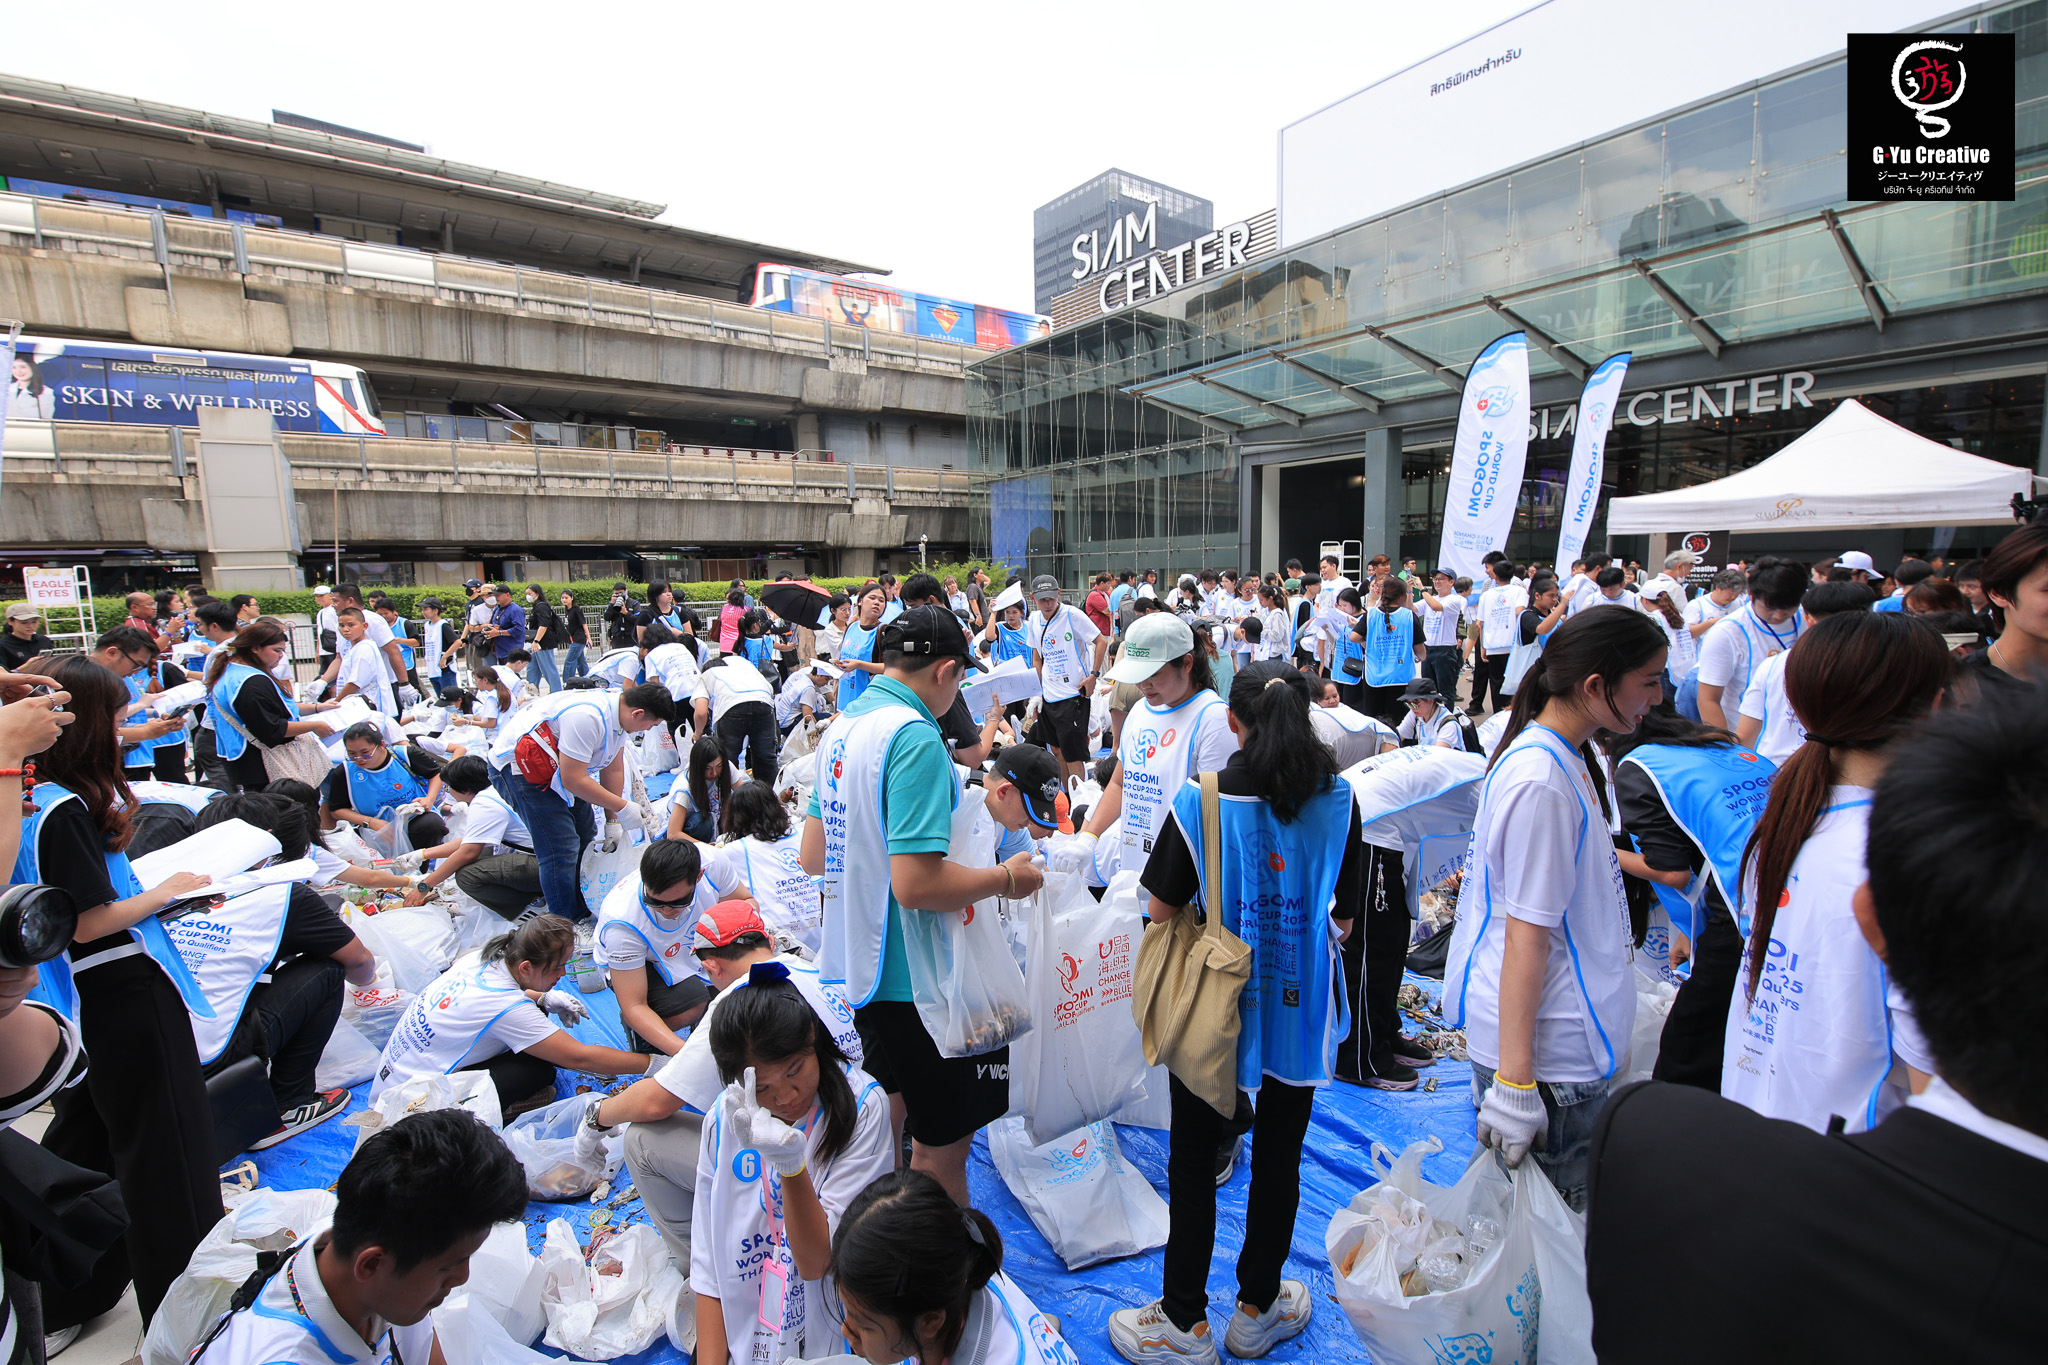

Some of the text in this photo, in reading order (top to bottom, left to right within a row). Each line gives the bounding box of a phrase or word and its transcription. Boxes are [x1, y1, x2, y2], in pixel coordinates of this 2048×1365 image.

[1430, 48, 1522, 97] สิทธิพิเศษสำหรับ
[1071, 200, 1158, 280] SIAM
[1099, 221, 1251, 314] CENTER
[62, 385, 135, 408] SKIN
[143, 393, 163, 410] &
[1626, 371, 1816, 427] CENTER
[1754, 511, 1775, 519] SIAM
[32, 580, 72, 589] EAGLE
[38, 589, 70, 598] EYES
[357, 772, 365, 781] 3
[1132, 784, 1163, 797] CUP 2025
[1139, 793, 1162, 805] Qualifiers
[1726, 792, 1767, 811] WORLD
[1129, 803, 1152, 815] CHANGE
[1734, 804, 1764, 820] THAIL
[775, 874, 811, 889] SPOGO
[775, 884, 799, 896] WORLD
[1258, 911, 1281, 921] CUP
[165, 919, 233, 936] OGOMI
[178, 929, 232, 945] CUP 2025
[1114, 933, 1130, 946] 日本
[187, 939, 227, 954] Qualifiers
[670, 944, 678, 956] 2
[1258, 937, 1297, 953] CHANGE
[1275, 956, 1297, 970] BLUE
[1286, 951, 1297, 960] THE
[1098, 970, 1131, 987] CHANGE
[1113, 984, 1132, 997] BLUE
[1074, 1000, 1088, 1011] CUP
[404, 1027, 425, 1054] Qualifiers
[413, 1027, 432, 1048] 2025
[833, 1029, 862, 1048] SPOG
[989, 1064, 1010, 1080] VIC
[741, 1153, 755, 1178] 6
[736, 1249, 774, 1269] WOR
